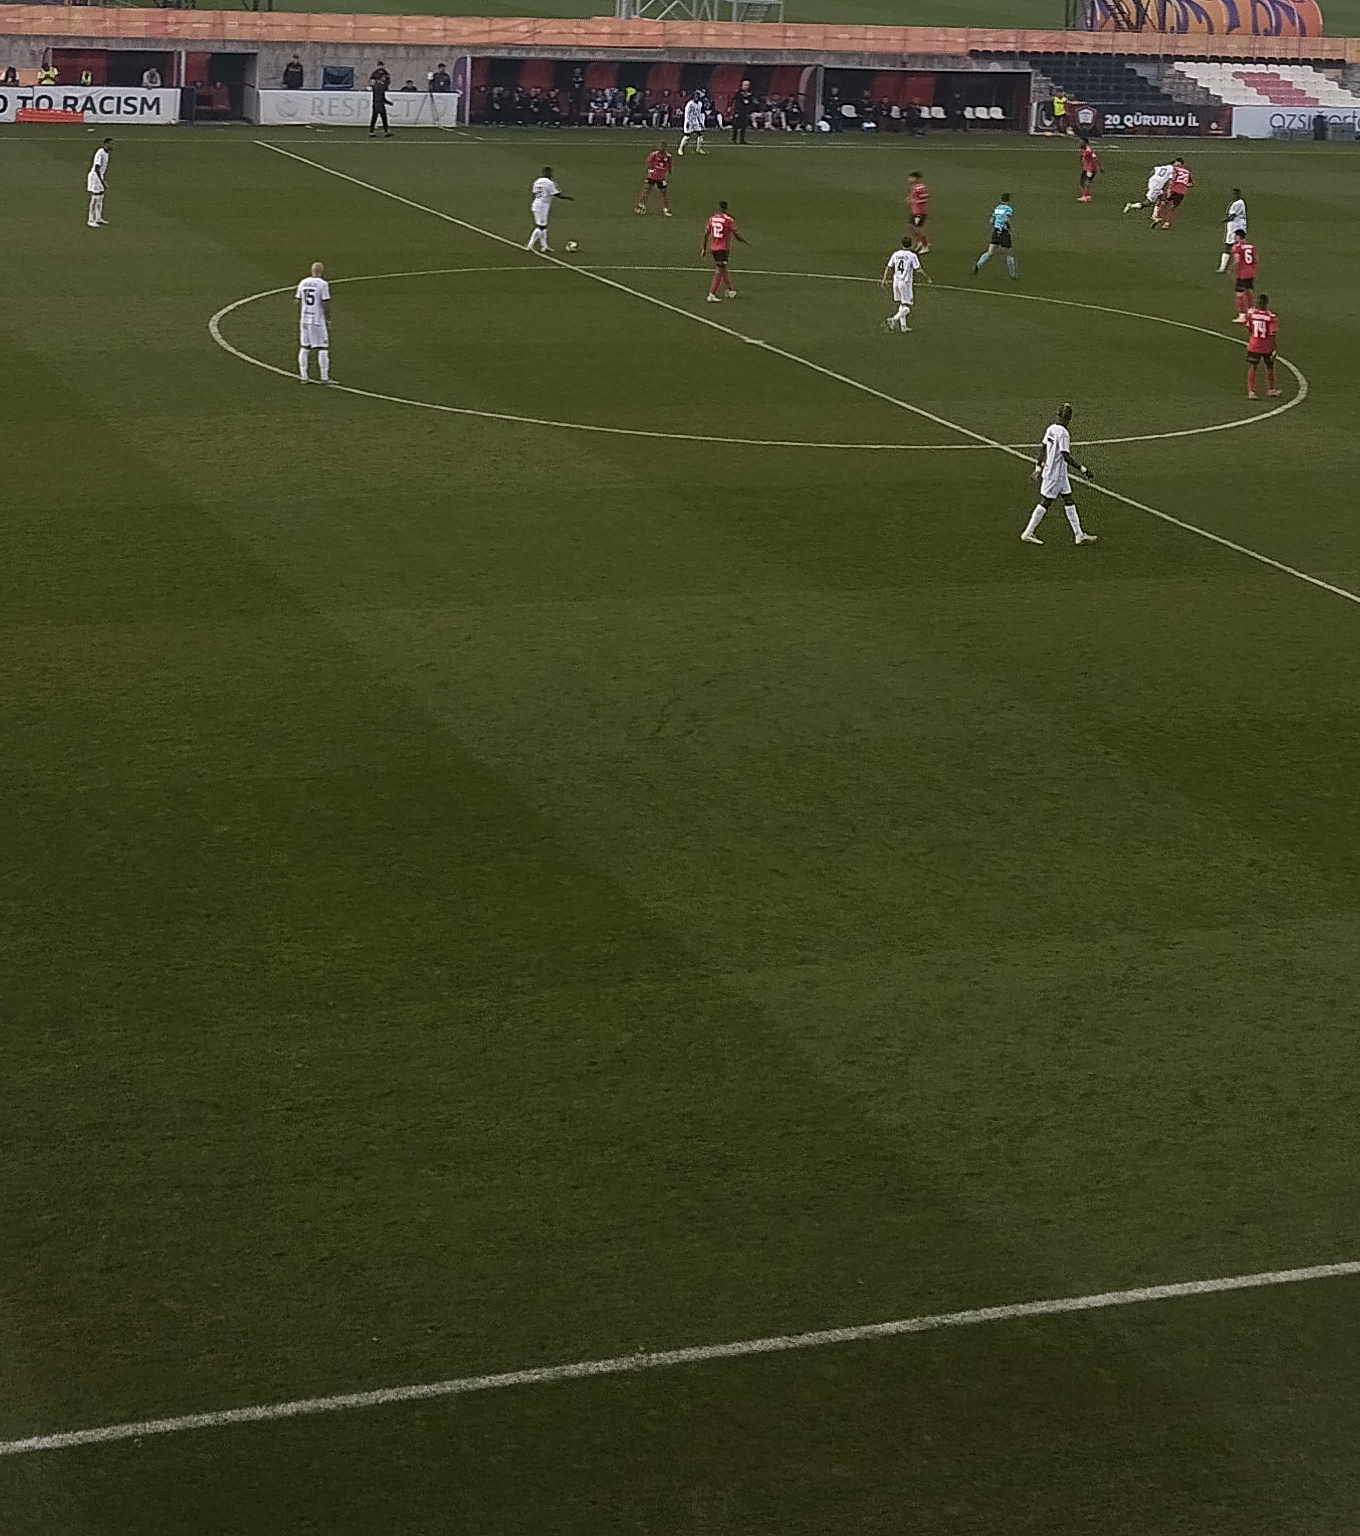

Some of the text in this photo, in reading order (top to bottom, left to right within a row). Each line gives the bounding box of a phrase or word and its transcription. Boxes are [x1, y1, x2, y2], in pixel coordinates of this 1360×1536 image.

[17, 94, 54, 109] TO
[63, 94, 161, 116] RACISM
[311, 97, 417, 118] RESPCT
[1104, 114, 1121, 126] 20
[1244, 249, 1253, 264] 6
[897, 259, 905, 275] 4
[1252, 320, 1267, 339] 14
